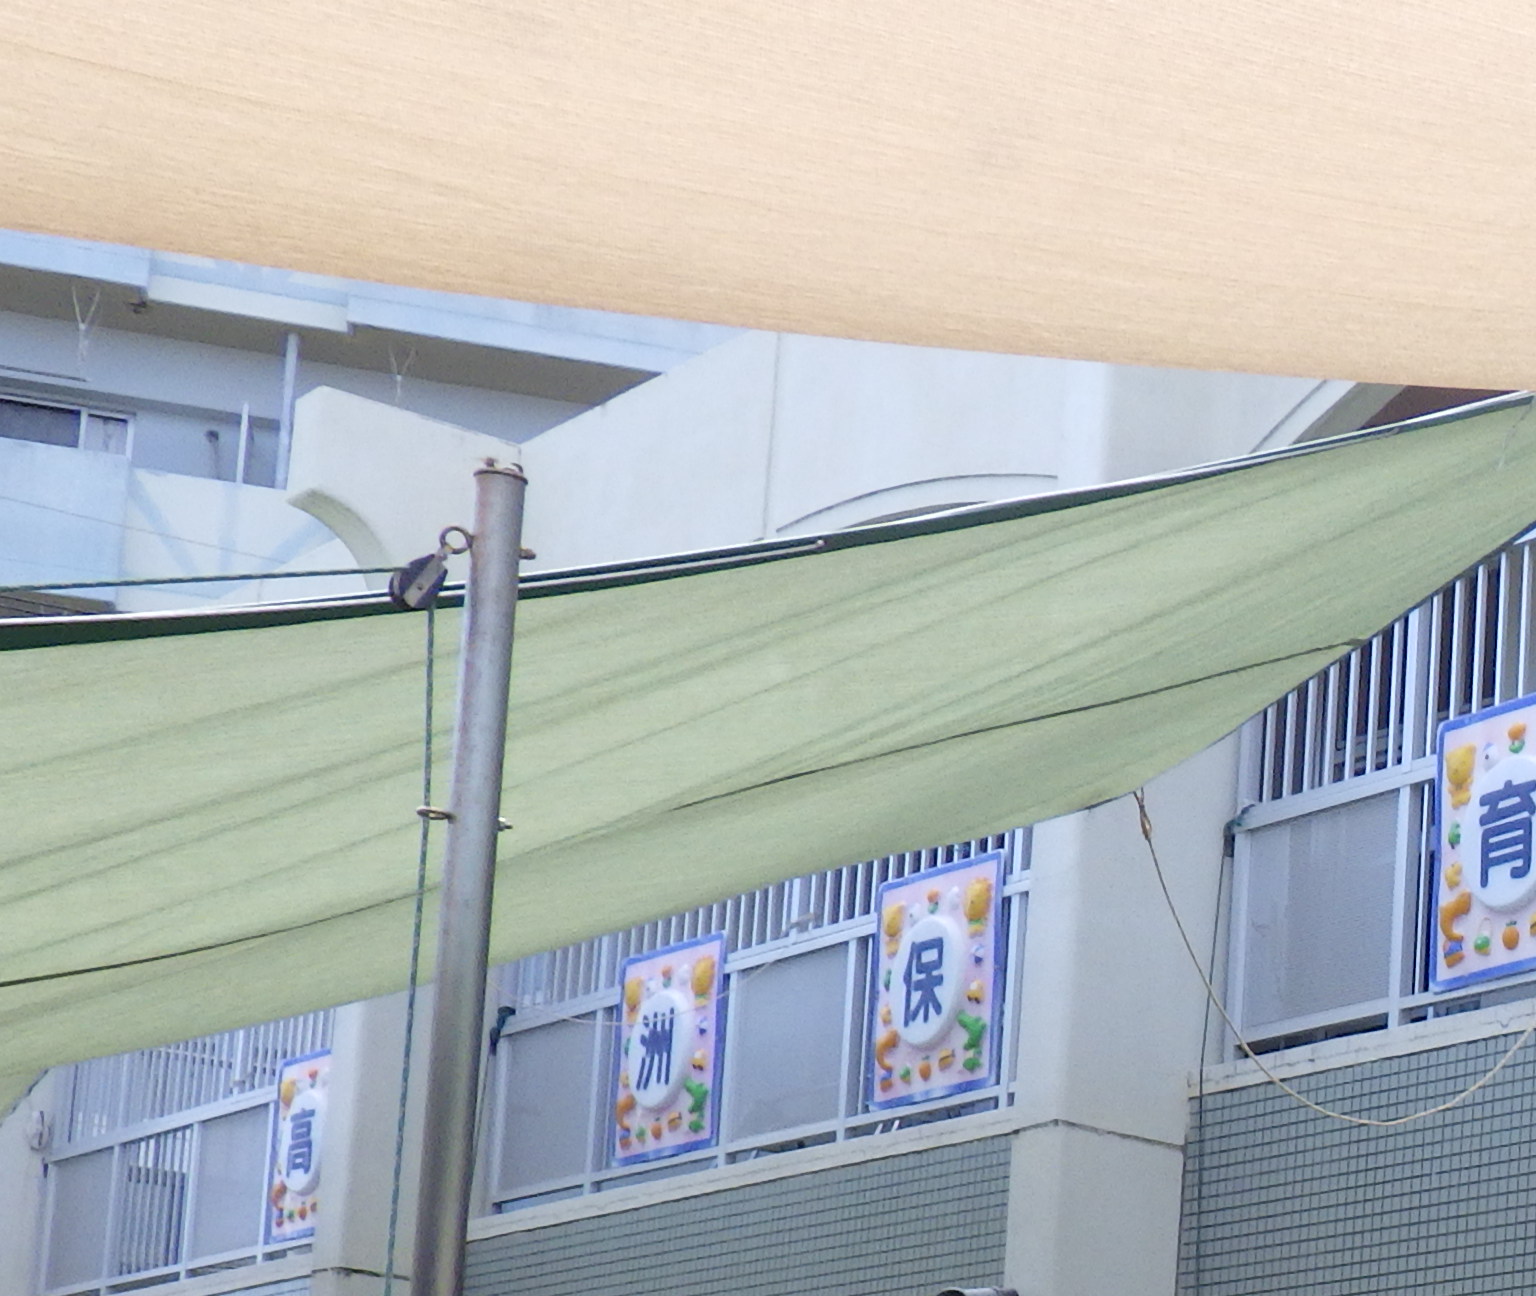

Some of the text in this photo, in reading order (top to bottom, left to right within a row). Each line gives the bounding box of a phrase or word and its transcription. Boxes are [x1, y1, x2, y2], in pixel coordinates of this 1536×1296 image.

[286, 1108, 316, 1179] 高
[638, 1012, 675, 1091] 洲
[903, 938, 944, 1029] 保
